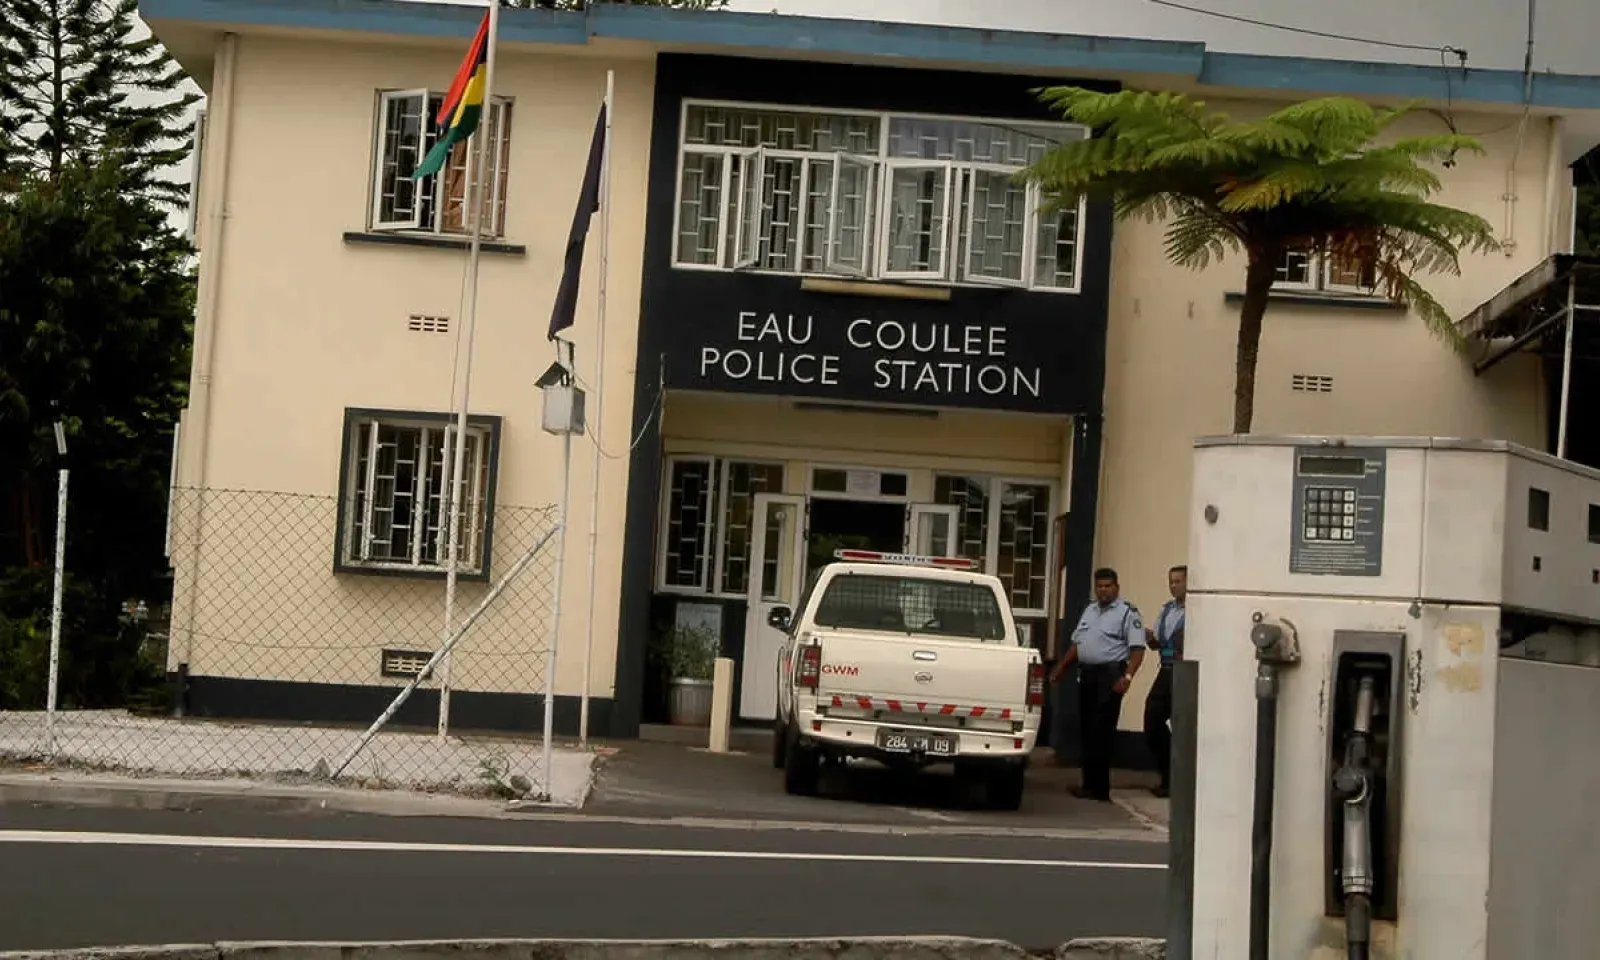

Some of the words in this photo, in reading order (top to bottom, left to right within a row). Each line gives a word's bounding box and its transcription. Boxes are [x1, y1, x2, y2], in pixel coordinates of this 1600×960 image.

[737, 311, 813, 344] EAU
[847, 319, 1006, 356] COULEE
[701, 347, 840, 385] POLICE
[874, 359, 1040, 397] STATION
[821, 664, 859, 676] GWM
[886, 735, 907, 748] 284
